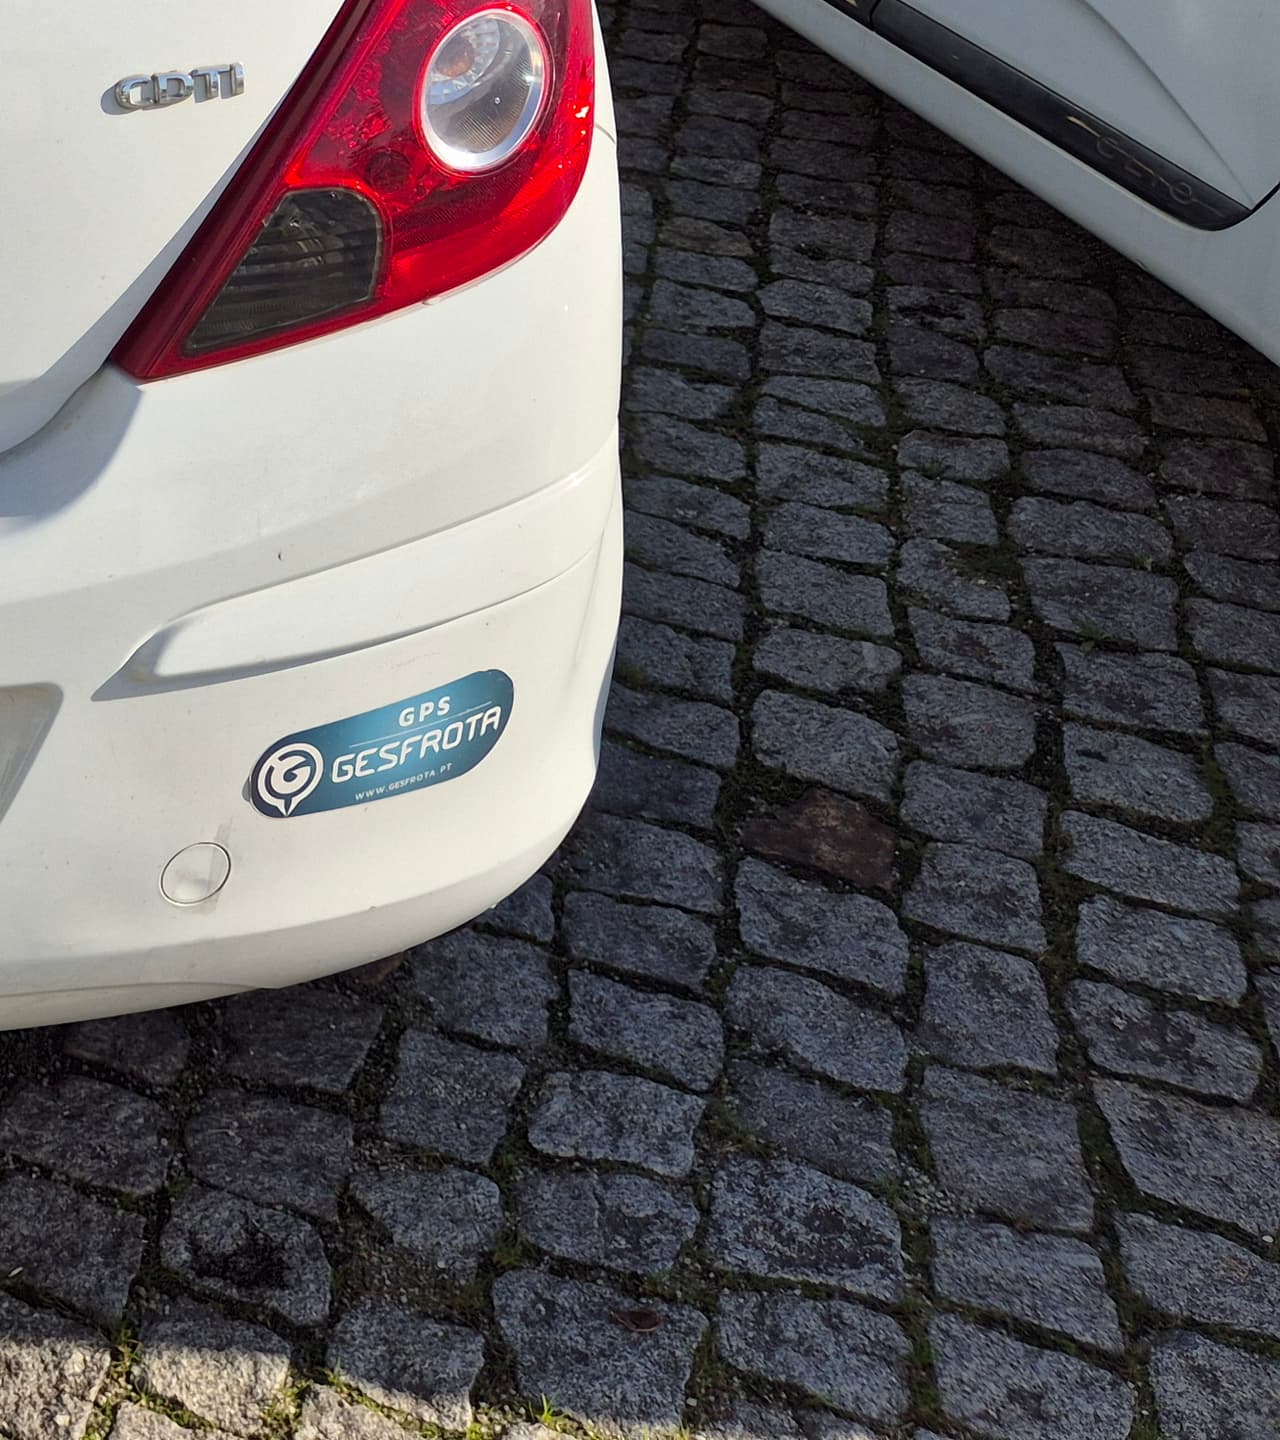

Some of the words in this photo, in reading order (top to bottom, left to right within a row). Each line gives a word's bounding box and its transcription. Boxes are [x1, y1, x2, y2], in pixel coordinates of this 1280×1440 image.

[114, 61, 245, 111] CDTI
[398, 695, 451, 727] GPS
[330, 705, 503, 784] GESFROTA
